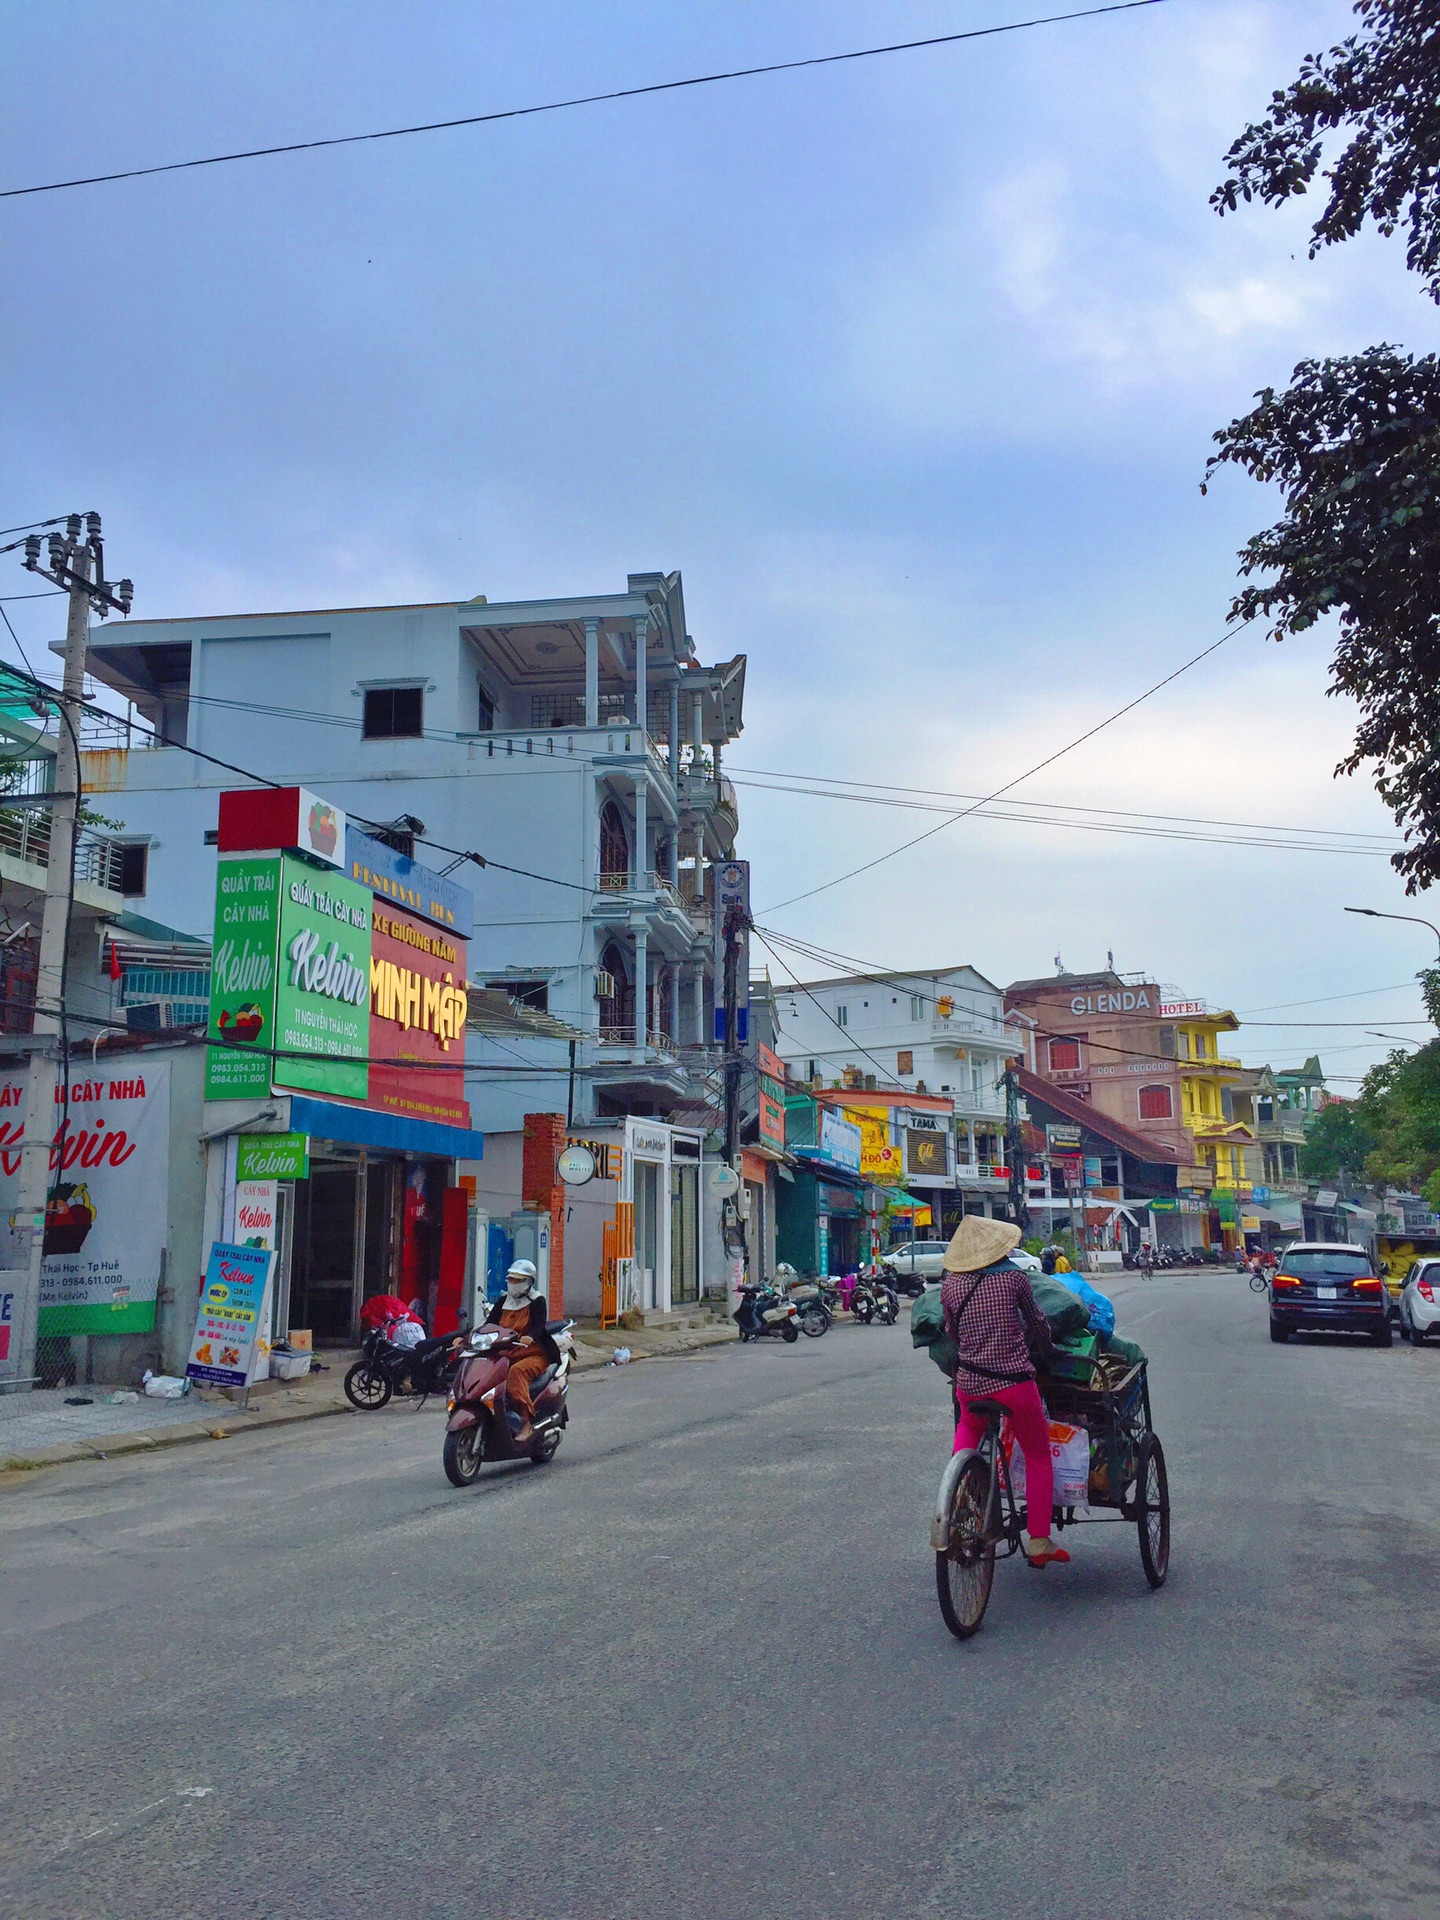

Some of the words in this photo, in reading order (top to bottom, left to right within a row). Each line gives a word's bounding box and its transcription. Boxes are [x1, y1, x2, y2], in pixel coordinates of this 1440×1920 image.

[253, 870, 274, 892] TRÁI
[352, 861, 424, 910] FESTIVAL
[223, 902, 246, 923] CÂY
[248, 900, 270, 922] NHÀ
[316, 891, 334, 917] TRÁI
[335, 899, 351, 924] CÂY
[351, 907, 368, 931] NHÀ
[373, 912, 388, 935] XE
[215, 938, 272, 995] Kelvin
[289, 927, 368, 1007] Kelvin
[369, 955, 421, 1031] MINH
[423, 971, 468, 1052] MẬP
[1070, 990, 1150, 1016] GLENDA
[1160, 1002, 1202, 1016] HOTEL
[329, 1012, 344, 1035] THÁI
[344, 1021, 358, 1040] HỌC
[210, 1074, 265, 1084] 0984.611.000
[211, 1063, 266, 1072] 0983.054.313
[71, 1080, 104, 1104] CÂY
[108, 1075, 147, 1100] NHÀ
[911, 1118, 936, 1130] TAMA
[0, 1118, 136, 1177] Klvin
[244, 1151, 298, 1176] Kelvin
[244, 1184, 256, 1196] CÂY
[239, 1205, 273, 1229] Kelvin
[62, 1262, 79, 1274] Học
[87, 1262, 100, 1274] Tp
[102, 1258, 120, 1272] Huế
[218, 1261, 254, 1285] Kelvin
[62, 1275, 122, 1287] 0984.611.000
